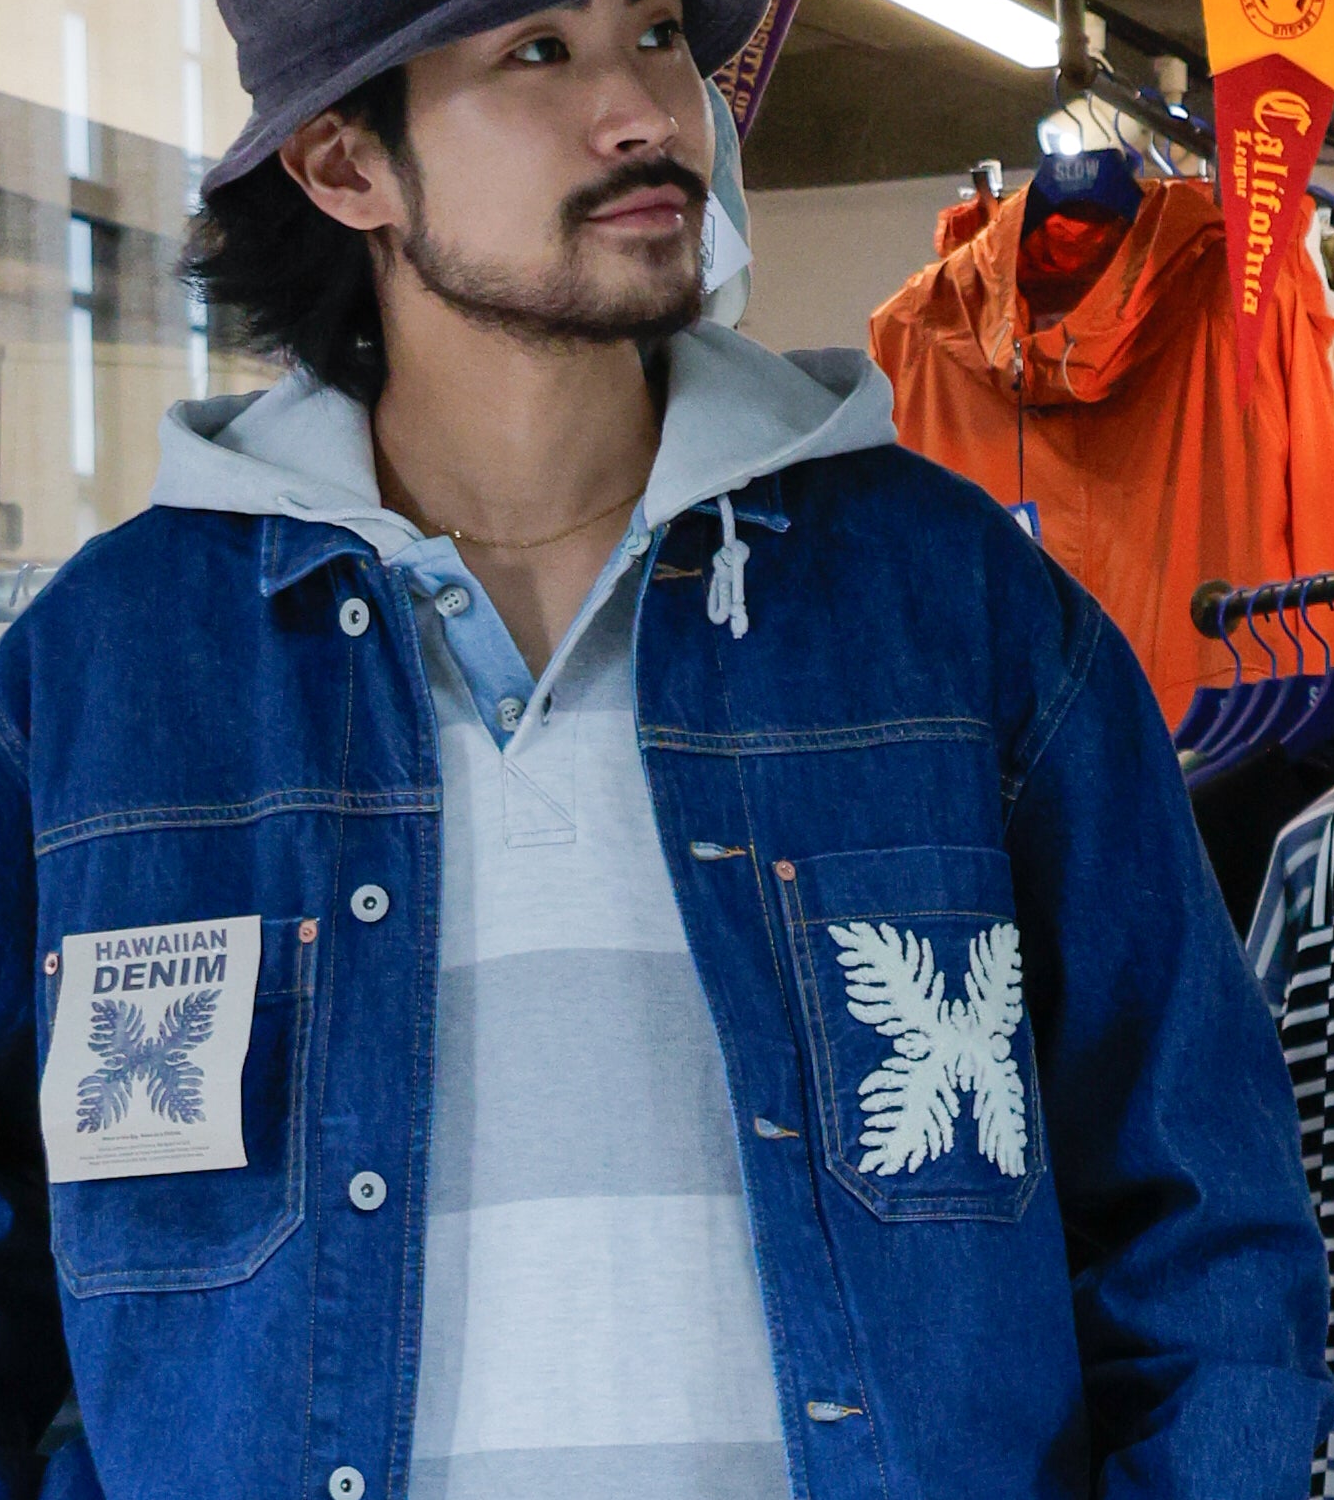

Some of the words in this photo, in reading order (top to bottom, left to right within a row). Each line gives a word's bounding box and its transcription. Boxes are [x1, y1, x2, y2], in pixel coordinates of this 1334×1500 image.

[1232, 129, 1252, 198] League
[1242, 88, 1313, 317] California
[95, 928, 228, 962] HAWAIIAN
[92, 954, 228, 995] DENIM
